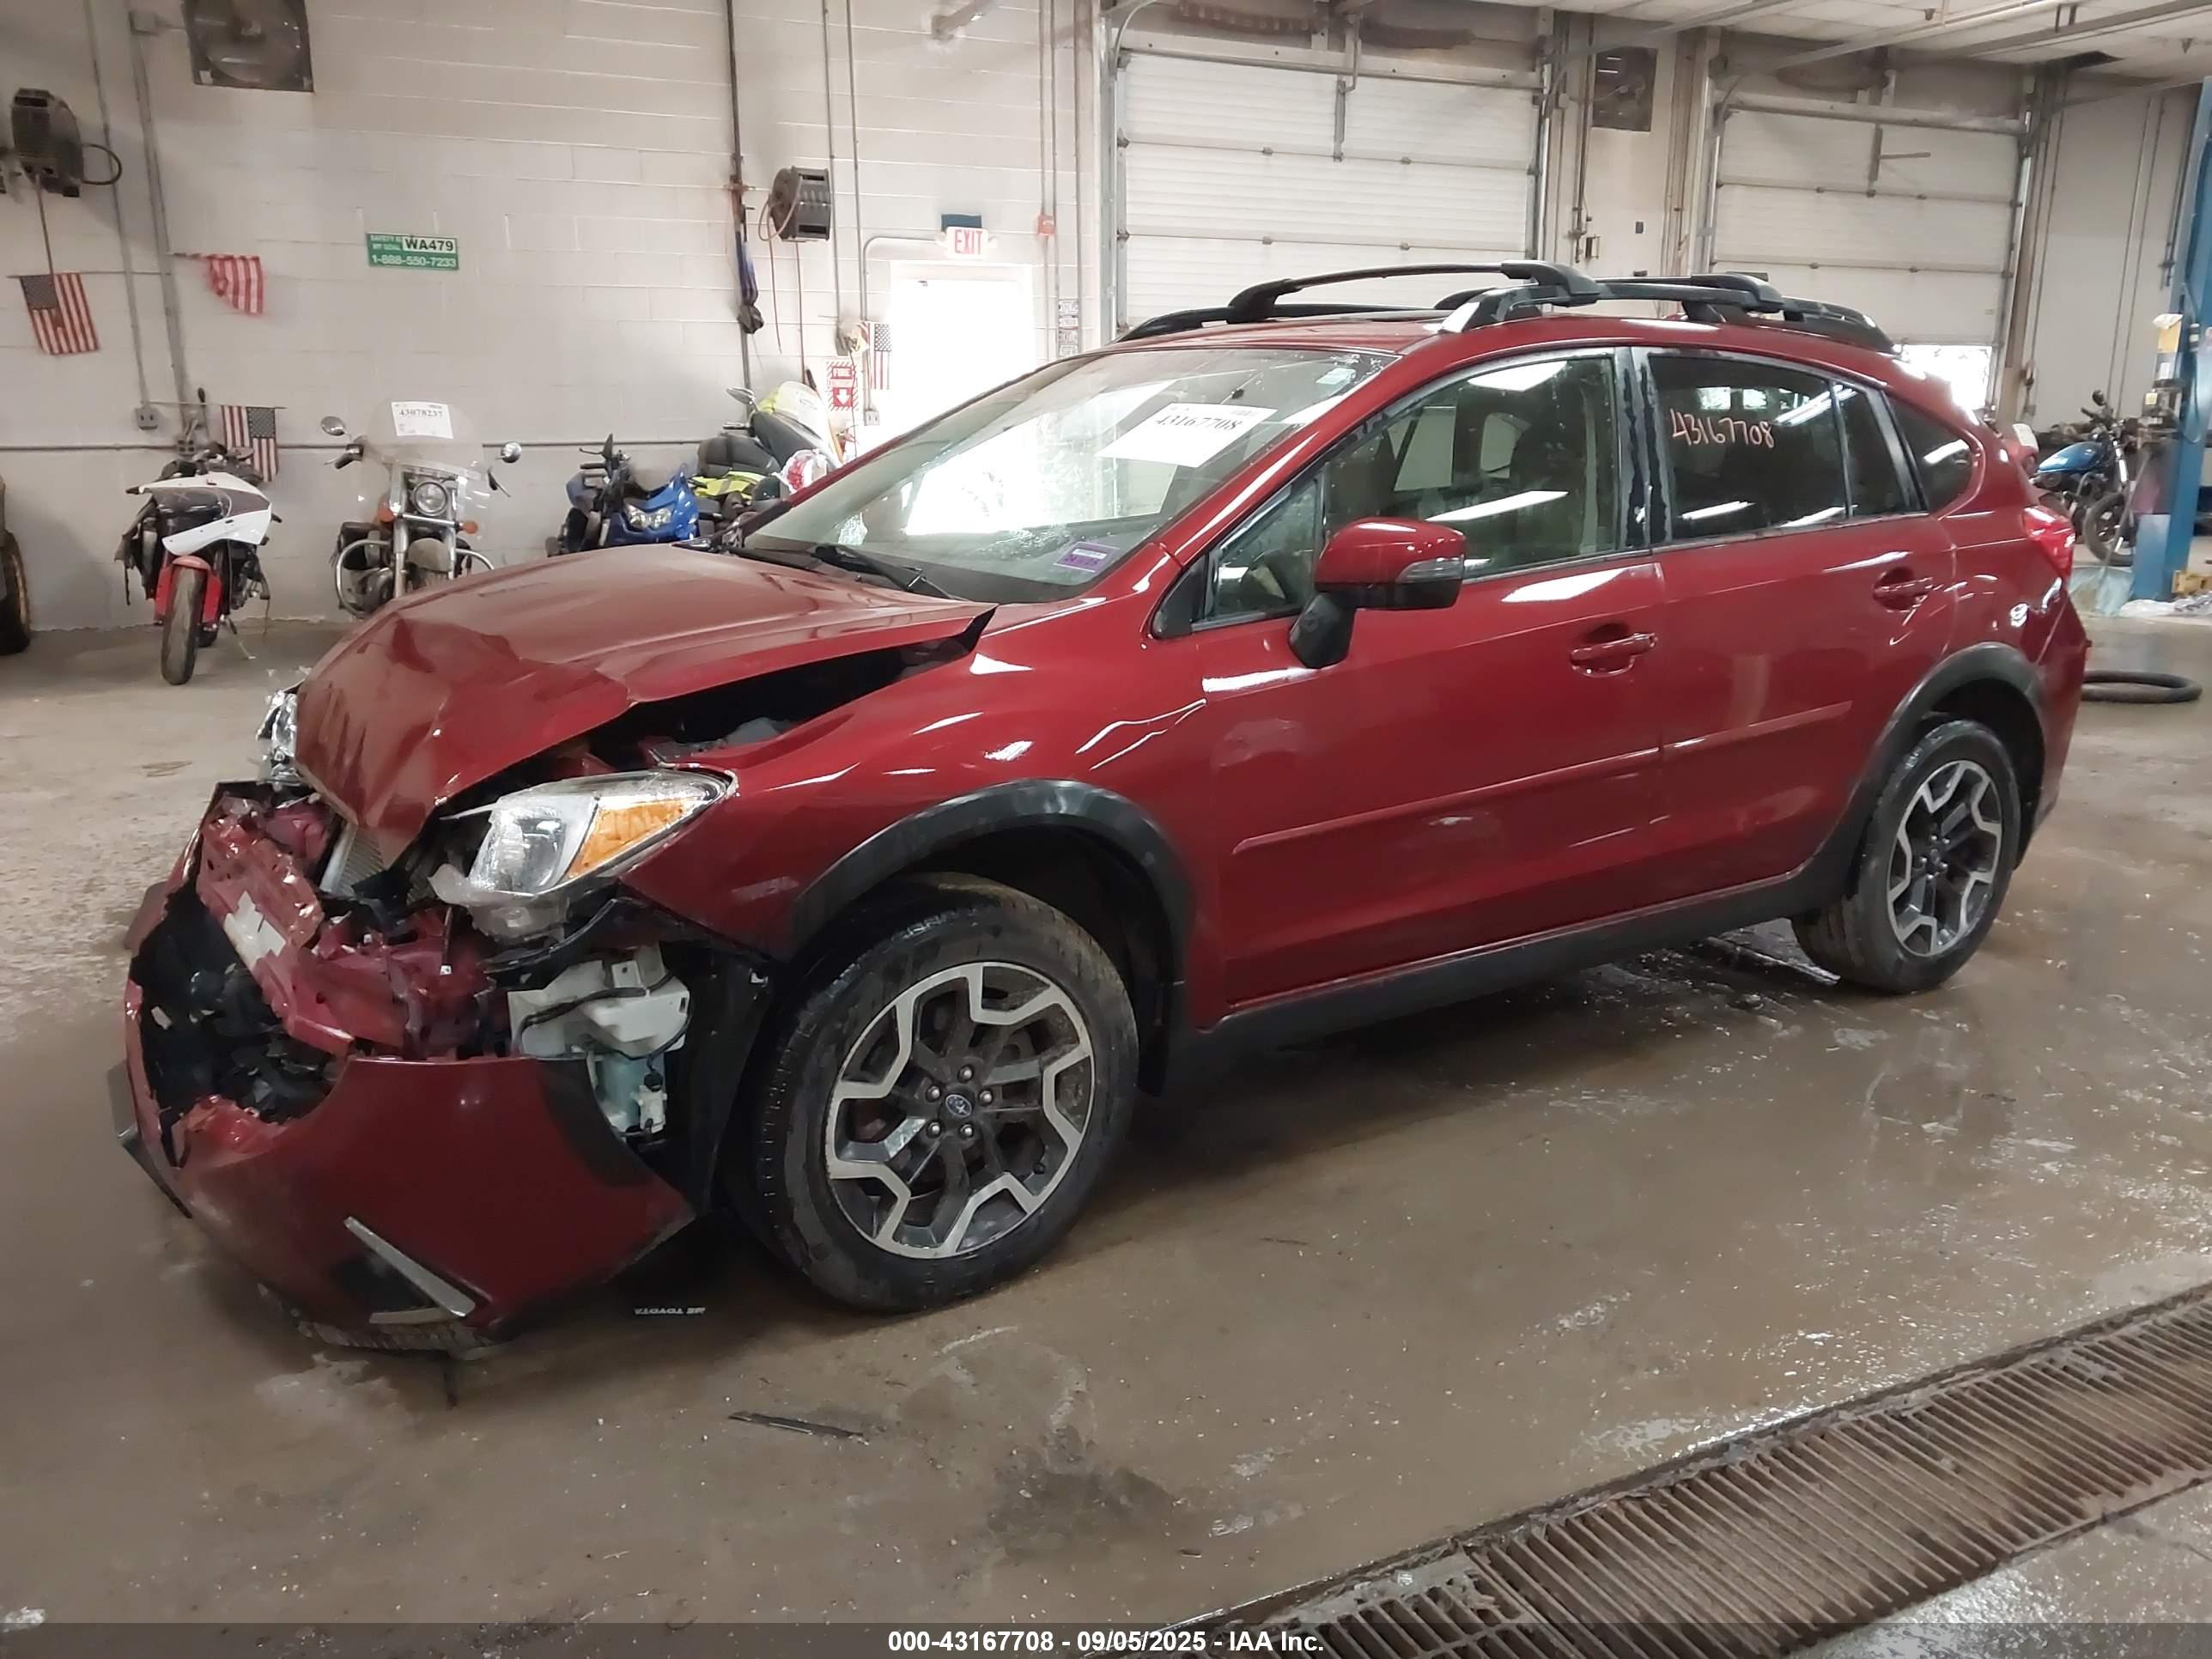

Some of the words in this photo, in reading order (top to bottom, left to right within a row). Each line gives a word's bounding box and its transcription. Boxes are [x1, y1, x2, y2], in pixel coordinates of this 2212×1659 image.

[404, 238, 454, 252] WA479
[954, 229, 982, 254] EXIT
[372, 254, 457, 268] 1-888-550-7233
[1155, 416, 1243, 430] 43167708
[1669, 408, 1774, 448] 43167708
